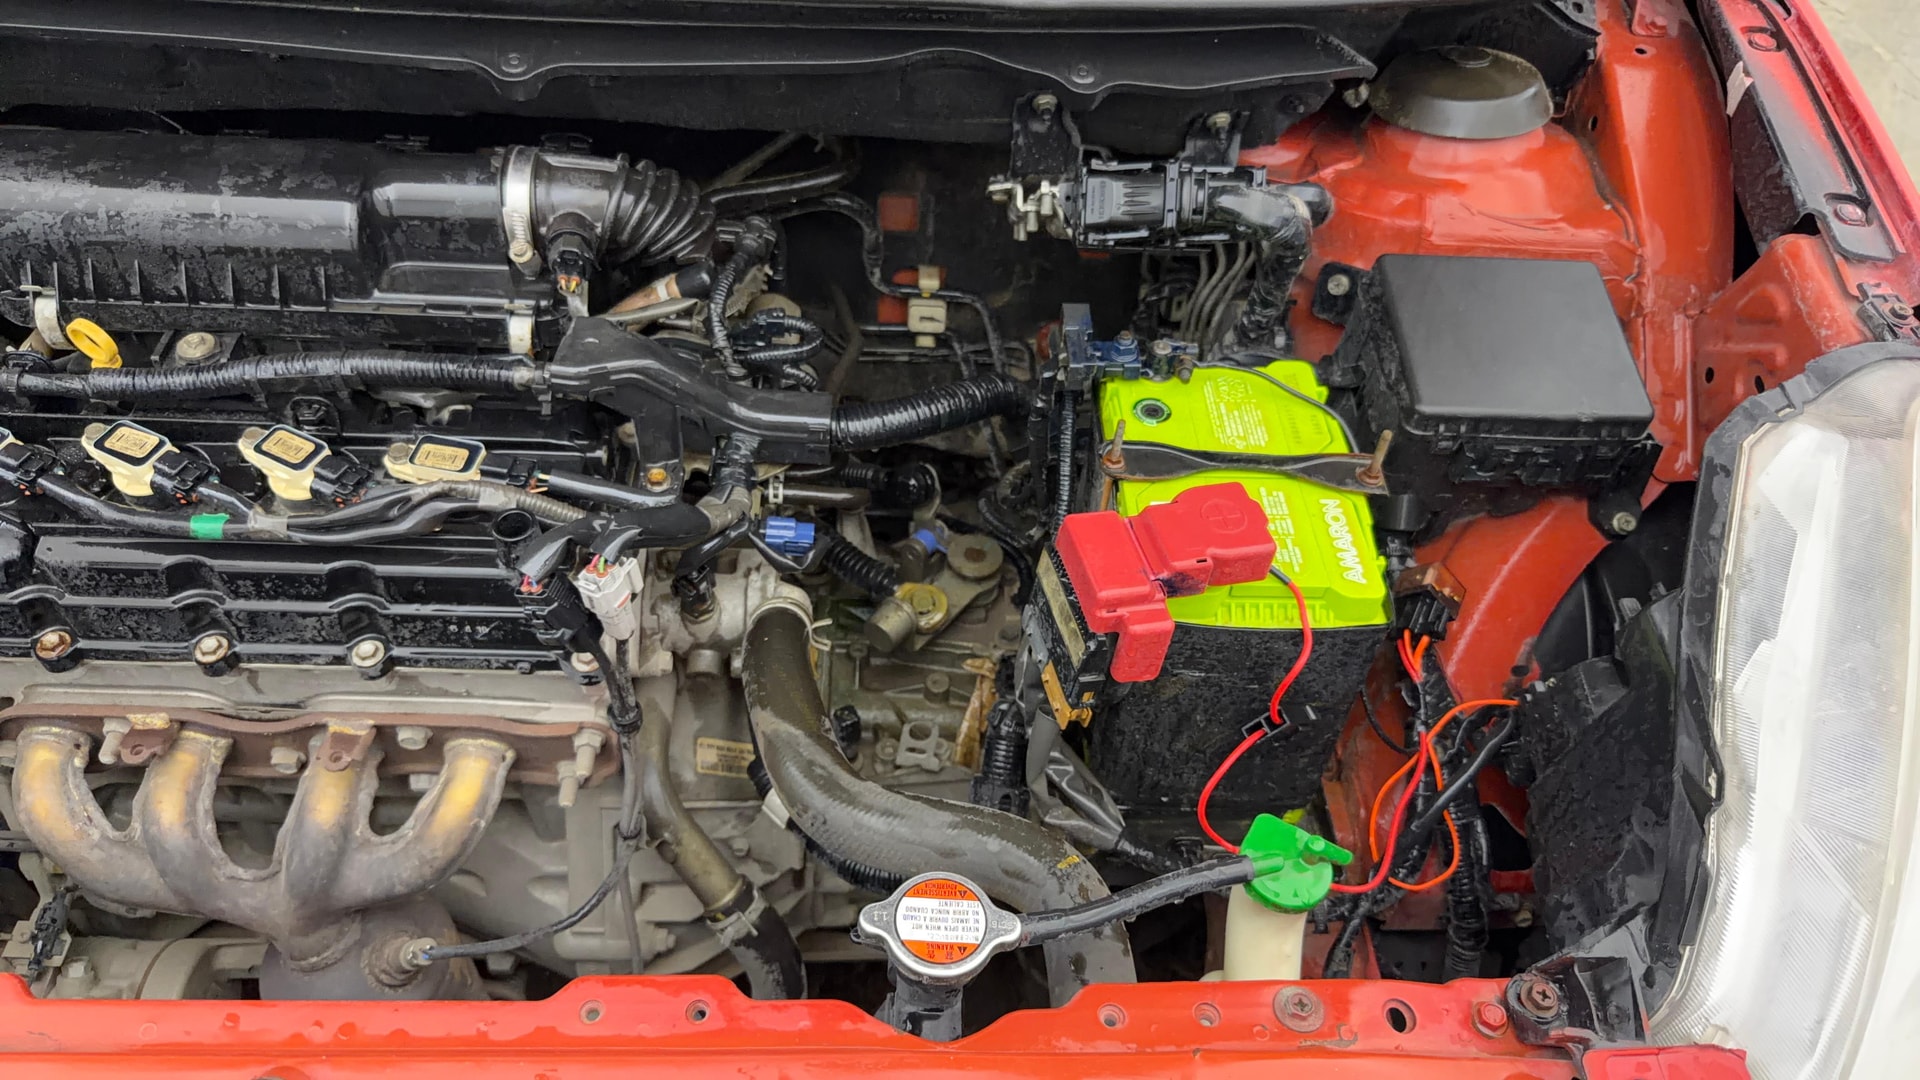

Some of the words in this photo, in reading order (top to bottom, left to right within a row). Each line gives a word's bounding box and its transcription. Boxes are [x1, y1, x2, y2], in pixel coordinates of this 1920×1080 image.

[1319, 499, 1367, 584] AMARON
[913, 888, 957, 897] AVERTISSEMENT
[874, 911, 889, 920] 1.1
